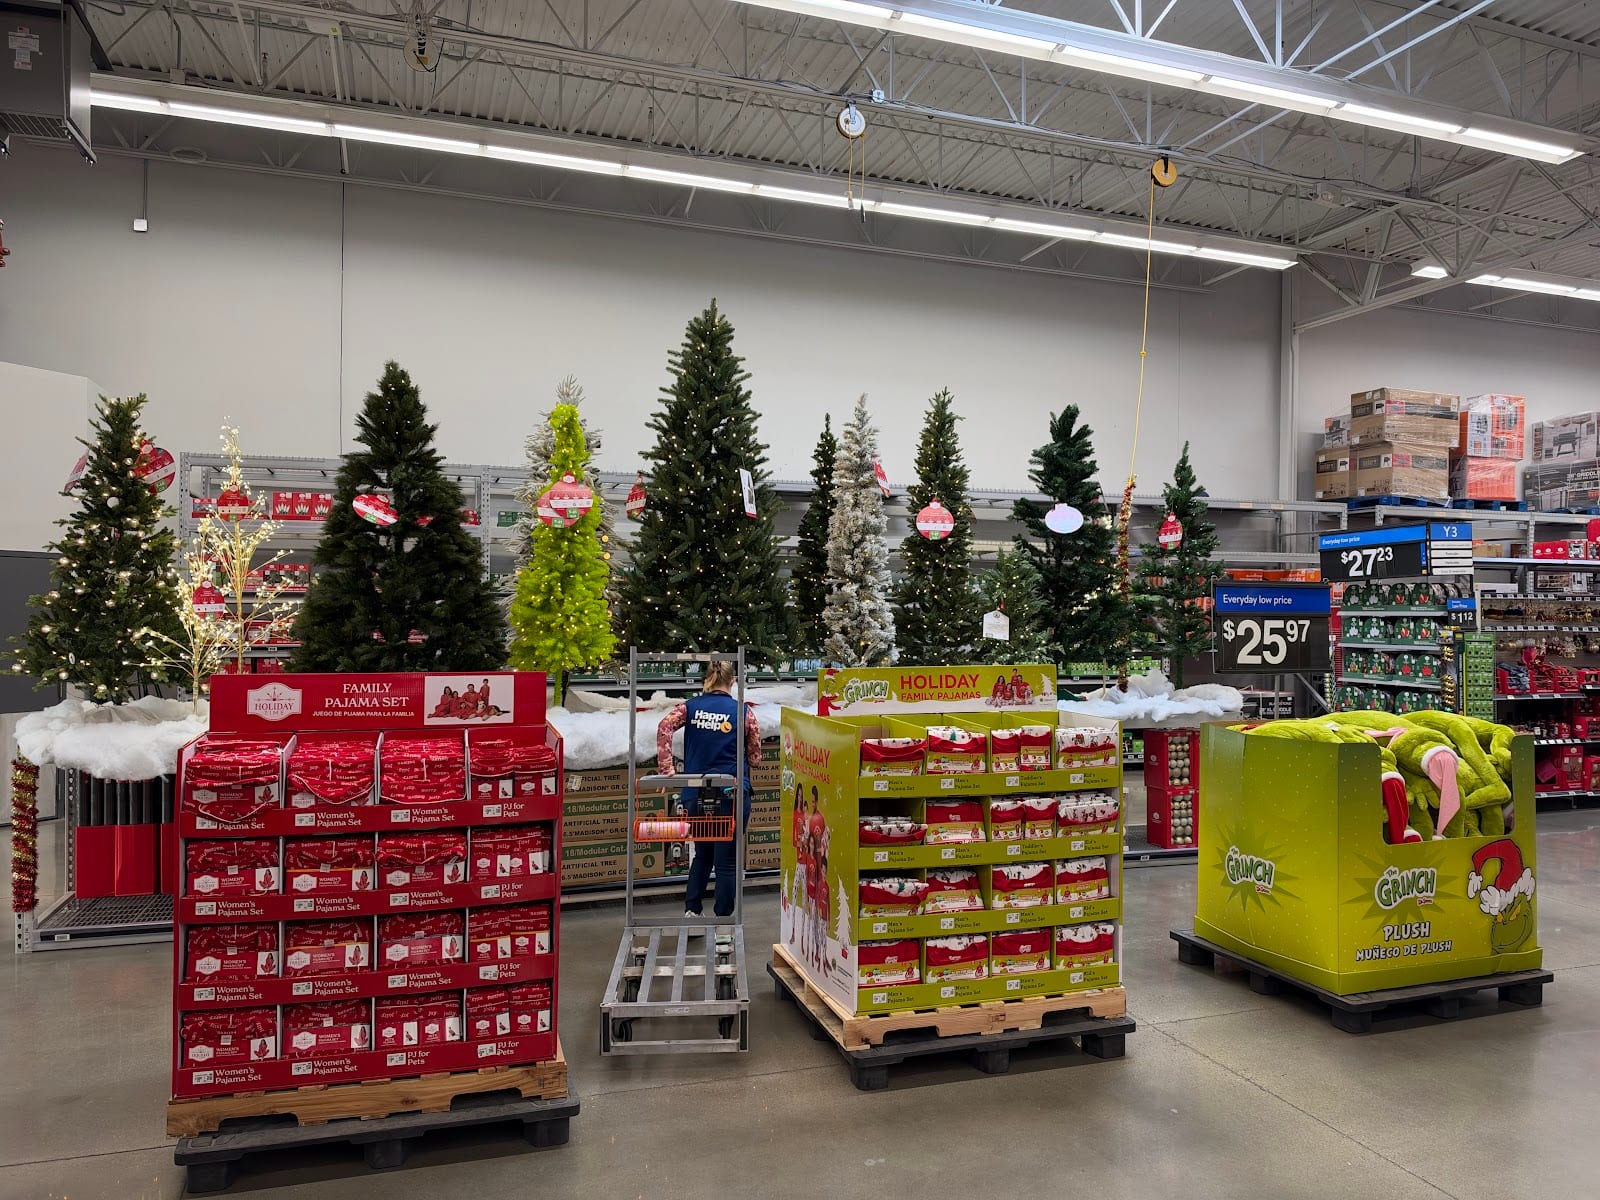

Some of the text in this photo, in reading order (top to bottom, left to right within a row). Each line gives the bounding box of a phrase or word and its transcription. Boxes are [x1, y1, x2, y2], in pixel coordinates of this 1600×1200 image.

[1443, 526, 1458, 538] Y3
[1322, 537, 1340, 545] Everyday
[1349, 536, 1360, 544] price
[1223, 594, 1293, 606] Everyday low price
[901, 674, 980, 690] HOLIDAY
[343, 683, 392, 694] FAMILY
[845, 681, 888, 701] GRINCH
[901, 691, 981, 701] FAMILY PAJAMAS
[325, 697, 409, 708] PAJAMA SET
[255, 703, 295, 711] HOLIDAY
[695, 710, 730, 721] Happy
[697, 720, 721, 731] Help
[794, 739, 831, 769] HOLIDAY
[809, 767, 831, 784] PAJAMAS
[412, 807, 448, 815] Women's
[567, 804, 610, 813] 18/Modular
[317, 811, 355, 819] Women's
[219, 823, 249, 831] Pajama
[317, 820, 346, 828] Pajama
[563, 819, 600, 827] ARTIFICIAL
[750, 834, 769, 842] Dept.
[566, 847, 608, 856] 18/Modular
[562, 862, 598, 870] ARTIFICIAL
[1227, 854, 1274, 885] GRINCH
[1387, 869, 1397, 877] The
[1377, 870, 1436, 907] GRINCH
[410, 890, 443, 898] Women's
[218, 900, 255, 908] Women's
[316, 896, 353, 904] Women's
[218, 909, 248, 917] Pajama
[316, 905, 345, 913] Pajama
[1383, 921, 1430, 942] PLUSH
[1356, 940, 1452, 962] MUÑECO DE PLUSH
[409, 971, 441, 980] Women's
[500, 970, 516, 978] Pets
[314, 979, 352, 987] Women's
[409, 980, 437, 988] Pajama
[216, 985, 254, 993] Women's
[314, 988, 343, 996] Pajama
[217, 994, 247, 1002] Pajama
[313, 1058, 351, 1067] Women's
[215, 1067, 254, 1076] Women's
[216, 1076, 246, 1084] Pajama
